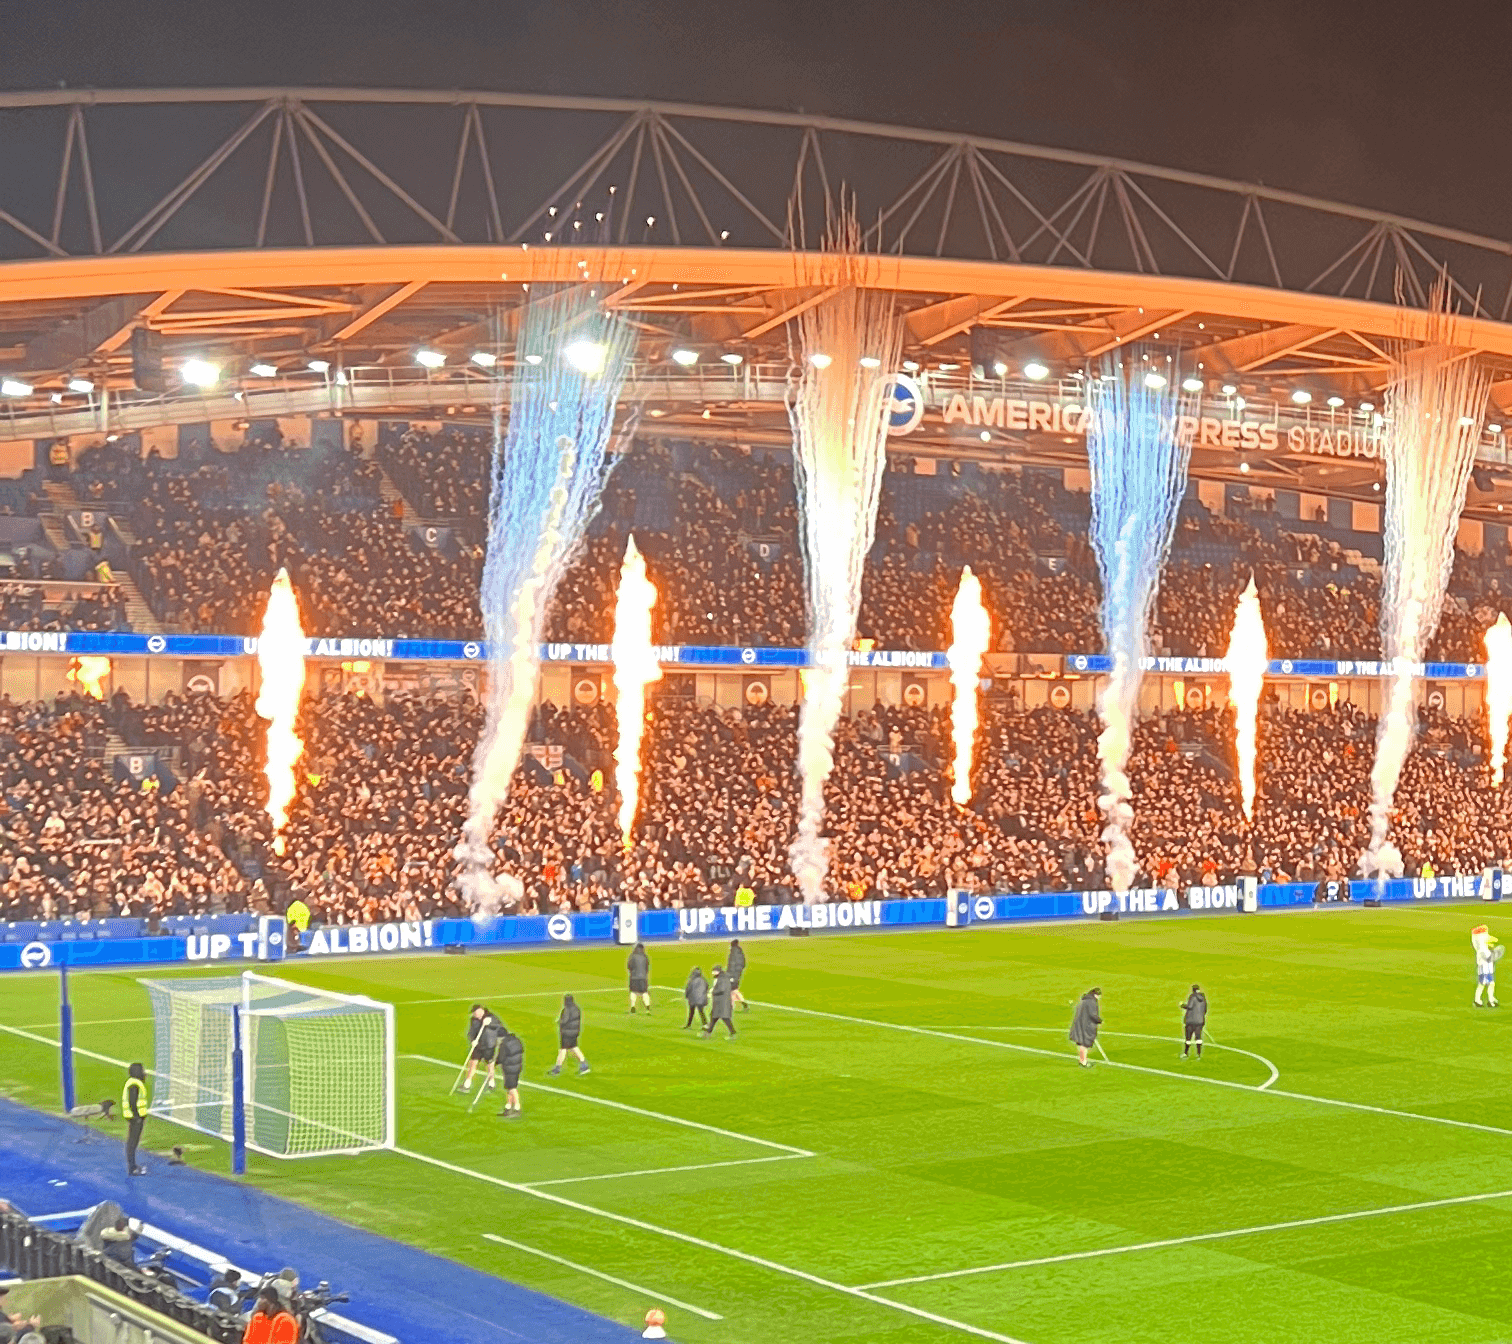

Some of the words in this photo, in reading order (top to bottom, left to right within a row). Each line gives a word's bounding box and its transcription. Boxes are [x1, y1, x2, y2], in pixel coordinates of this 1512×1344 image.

[944, 394, 1122, 438] AMERICA
[426, 528, 437, 542] C
[760, 544, 770, 557] D
[315, 638, 393, 657] ALBION!
[548, 643, 572, 660] UP
[575, 644, 609, 661] THE
[872, 651, 932, 667] ALBION!
[130, 757, 144, 774] B
[1412, 877, 1437, 898] UP
[1439, 875, 1475, 897] THE
[1082, 891, 1112, 914] UP
[1114, 888, 1158, 912] THE
[1162, 885, 1238, 911] ABION
[680, 907, 715, 934] UP
[721, 904, 771, 931] THE
[778, 901, 880, 929] ALBION!
[187, 934, 231, 960] UP
[308, 920, 433, 954] ALBION!
